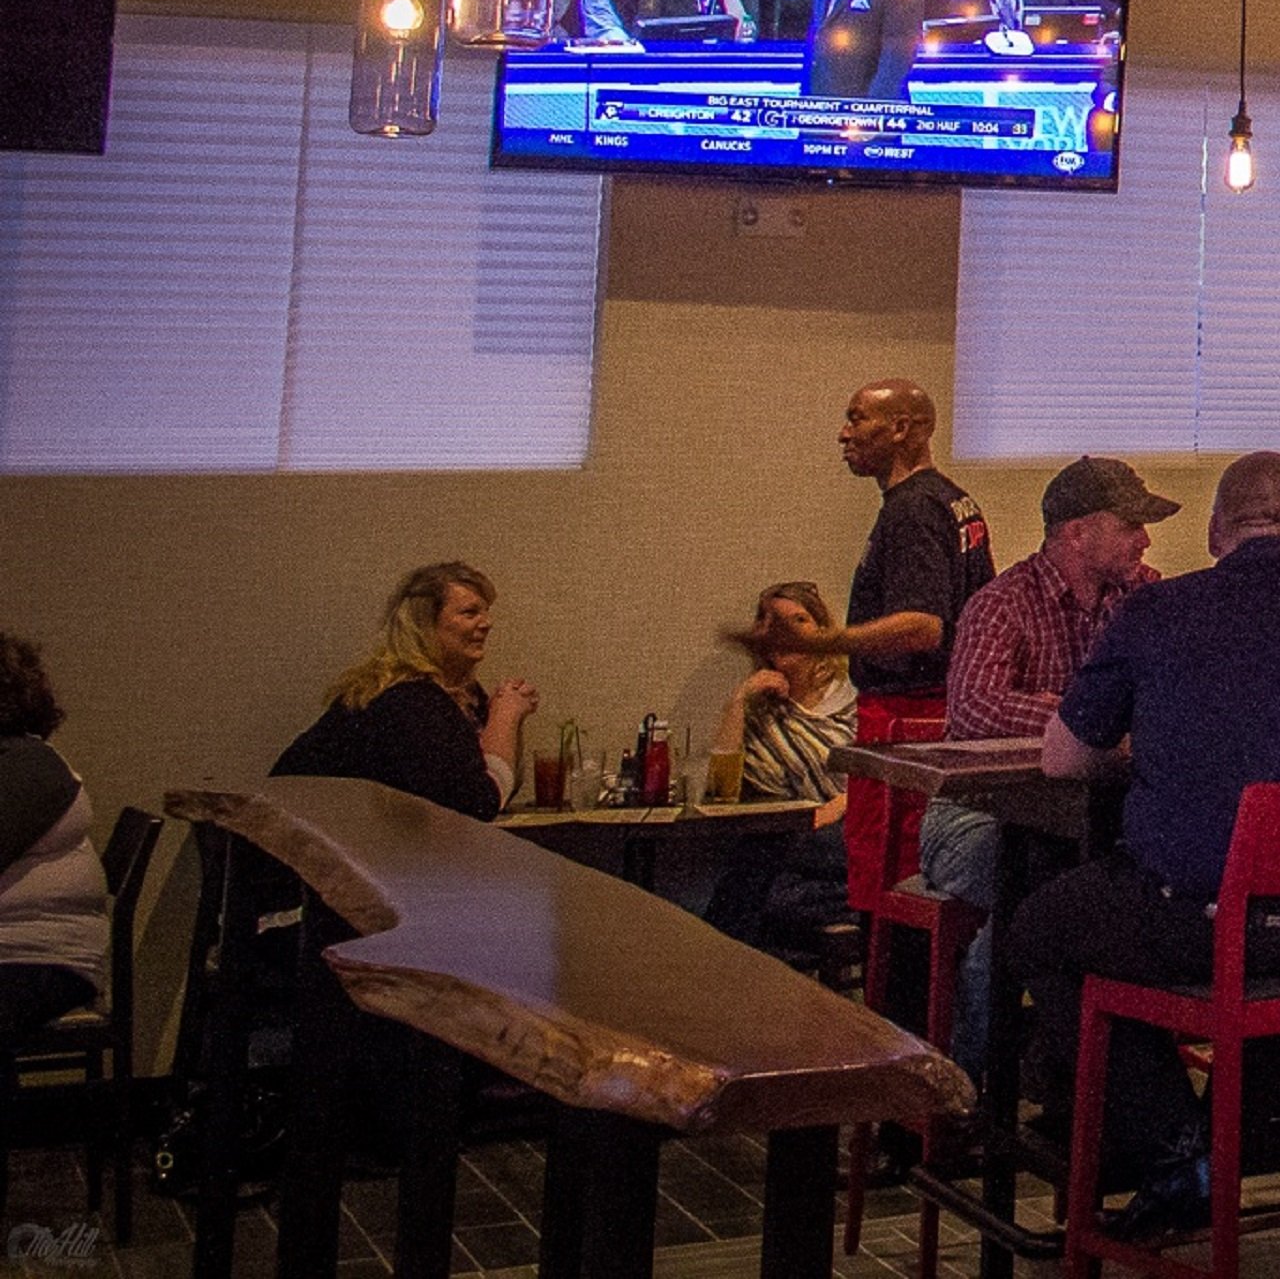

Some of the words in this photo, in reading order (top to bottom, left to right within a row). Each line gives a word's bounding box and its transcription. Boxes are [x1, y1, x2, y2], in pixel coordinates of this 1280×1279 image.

[707, 95, 728, 105] BIG
[729, 97, 759, 107] EAST
[762, 98, 840, 111] TOURNAMENT
[850, 103, 935, 116] QUARTERFINAL
[648, 108, 715, 120] CREIGHTON
[730, 110, 751, 122] 42
[798, 114, 878, 127] GEORGETOWN
[936, 122, 961, 132] HALF
[594, 135, 629, 147] KINGS
[701, 138, 752, 151] CANUCKS
